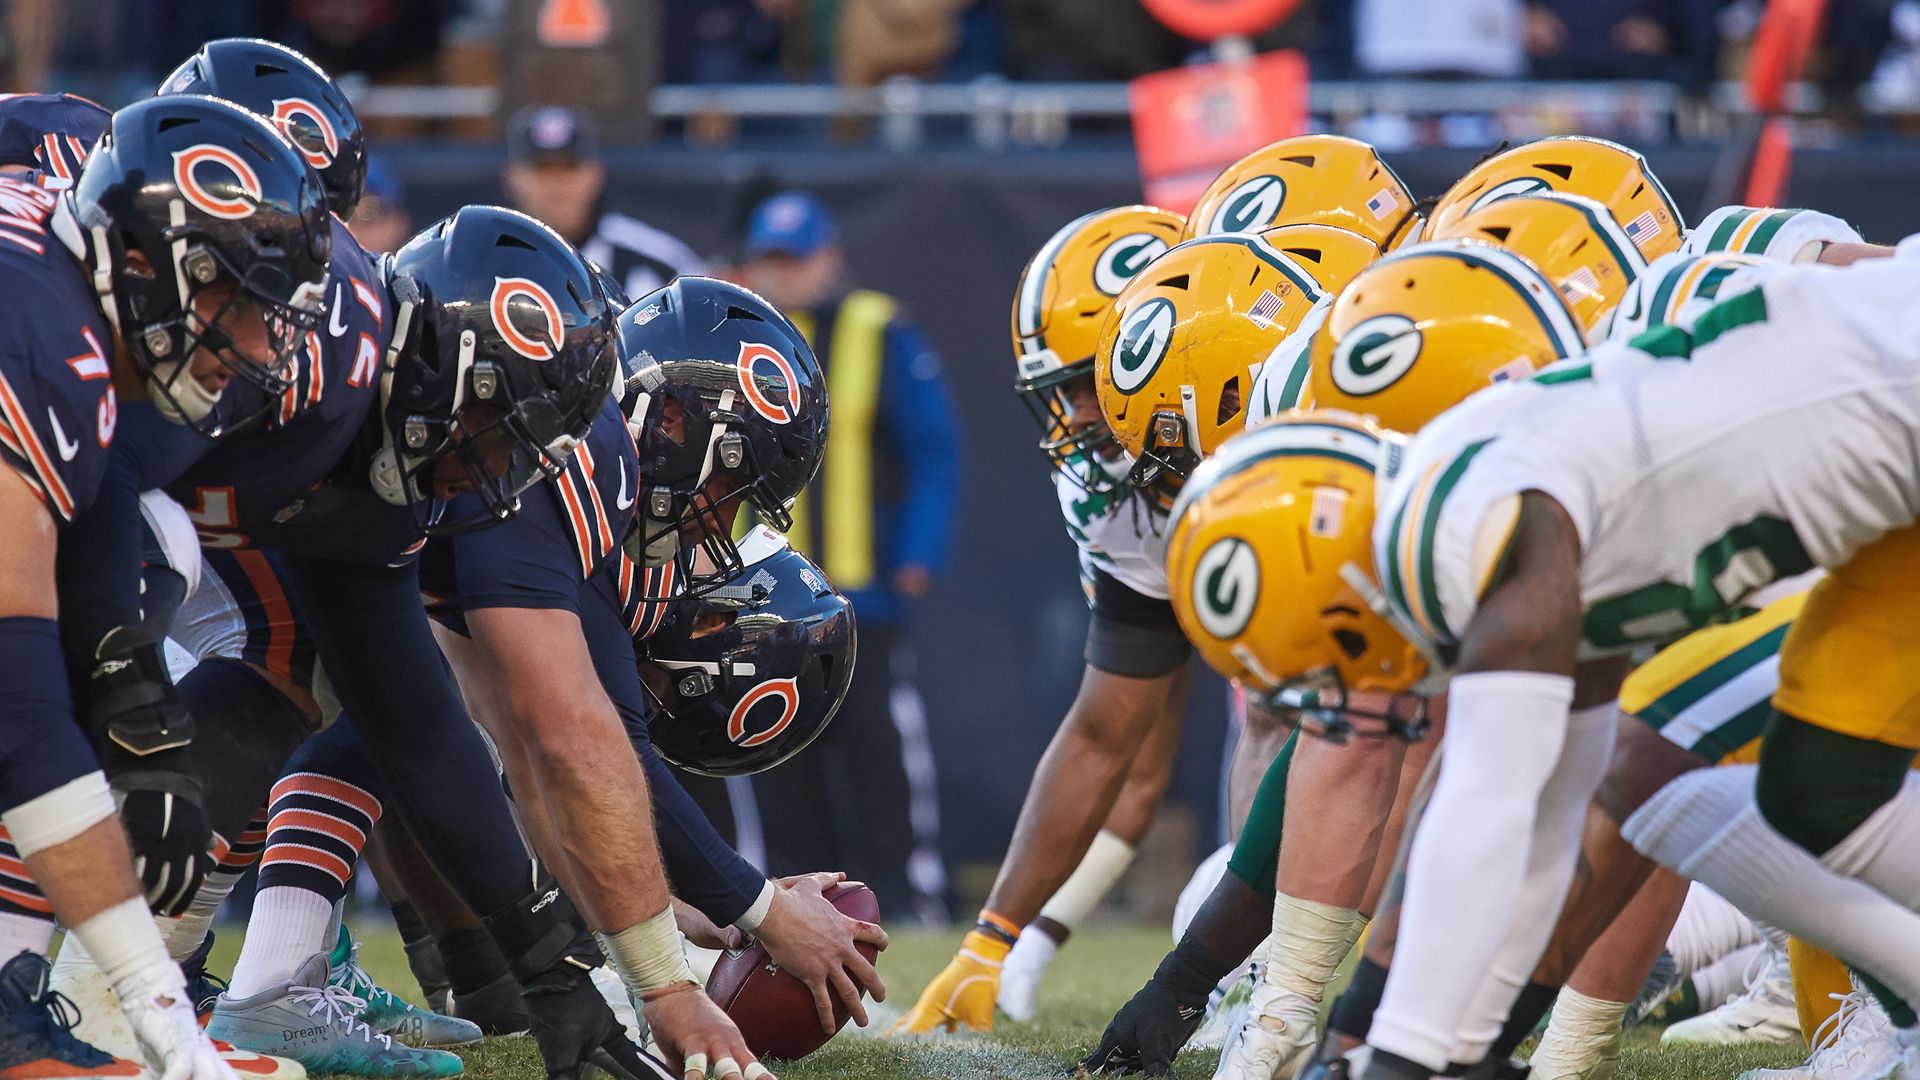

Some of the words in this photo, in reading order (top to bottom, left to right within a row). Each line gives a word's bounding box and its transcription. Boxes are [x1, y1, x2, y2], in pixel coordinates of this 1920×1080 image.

[171, 143, 262, 220] C
[489, 276, 565, 362] C
[1110, 296, 1176, 396] G
[1329, 313, 1423, 397] G
[736, 340, 801, 425] C
[1192, 535, 1261, 640] G
[282, 1025, 327, 1042] Dream
